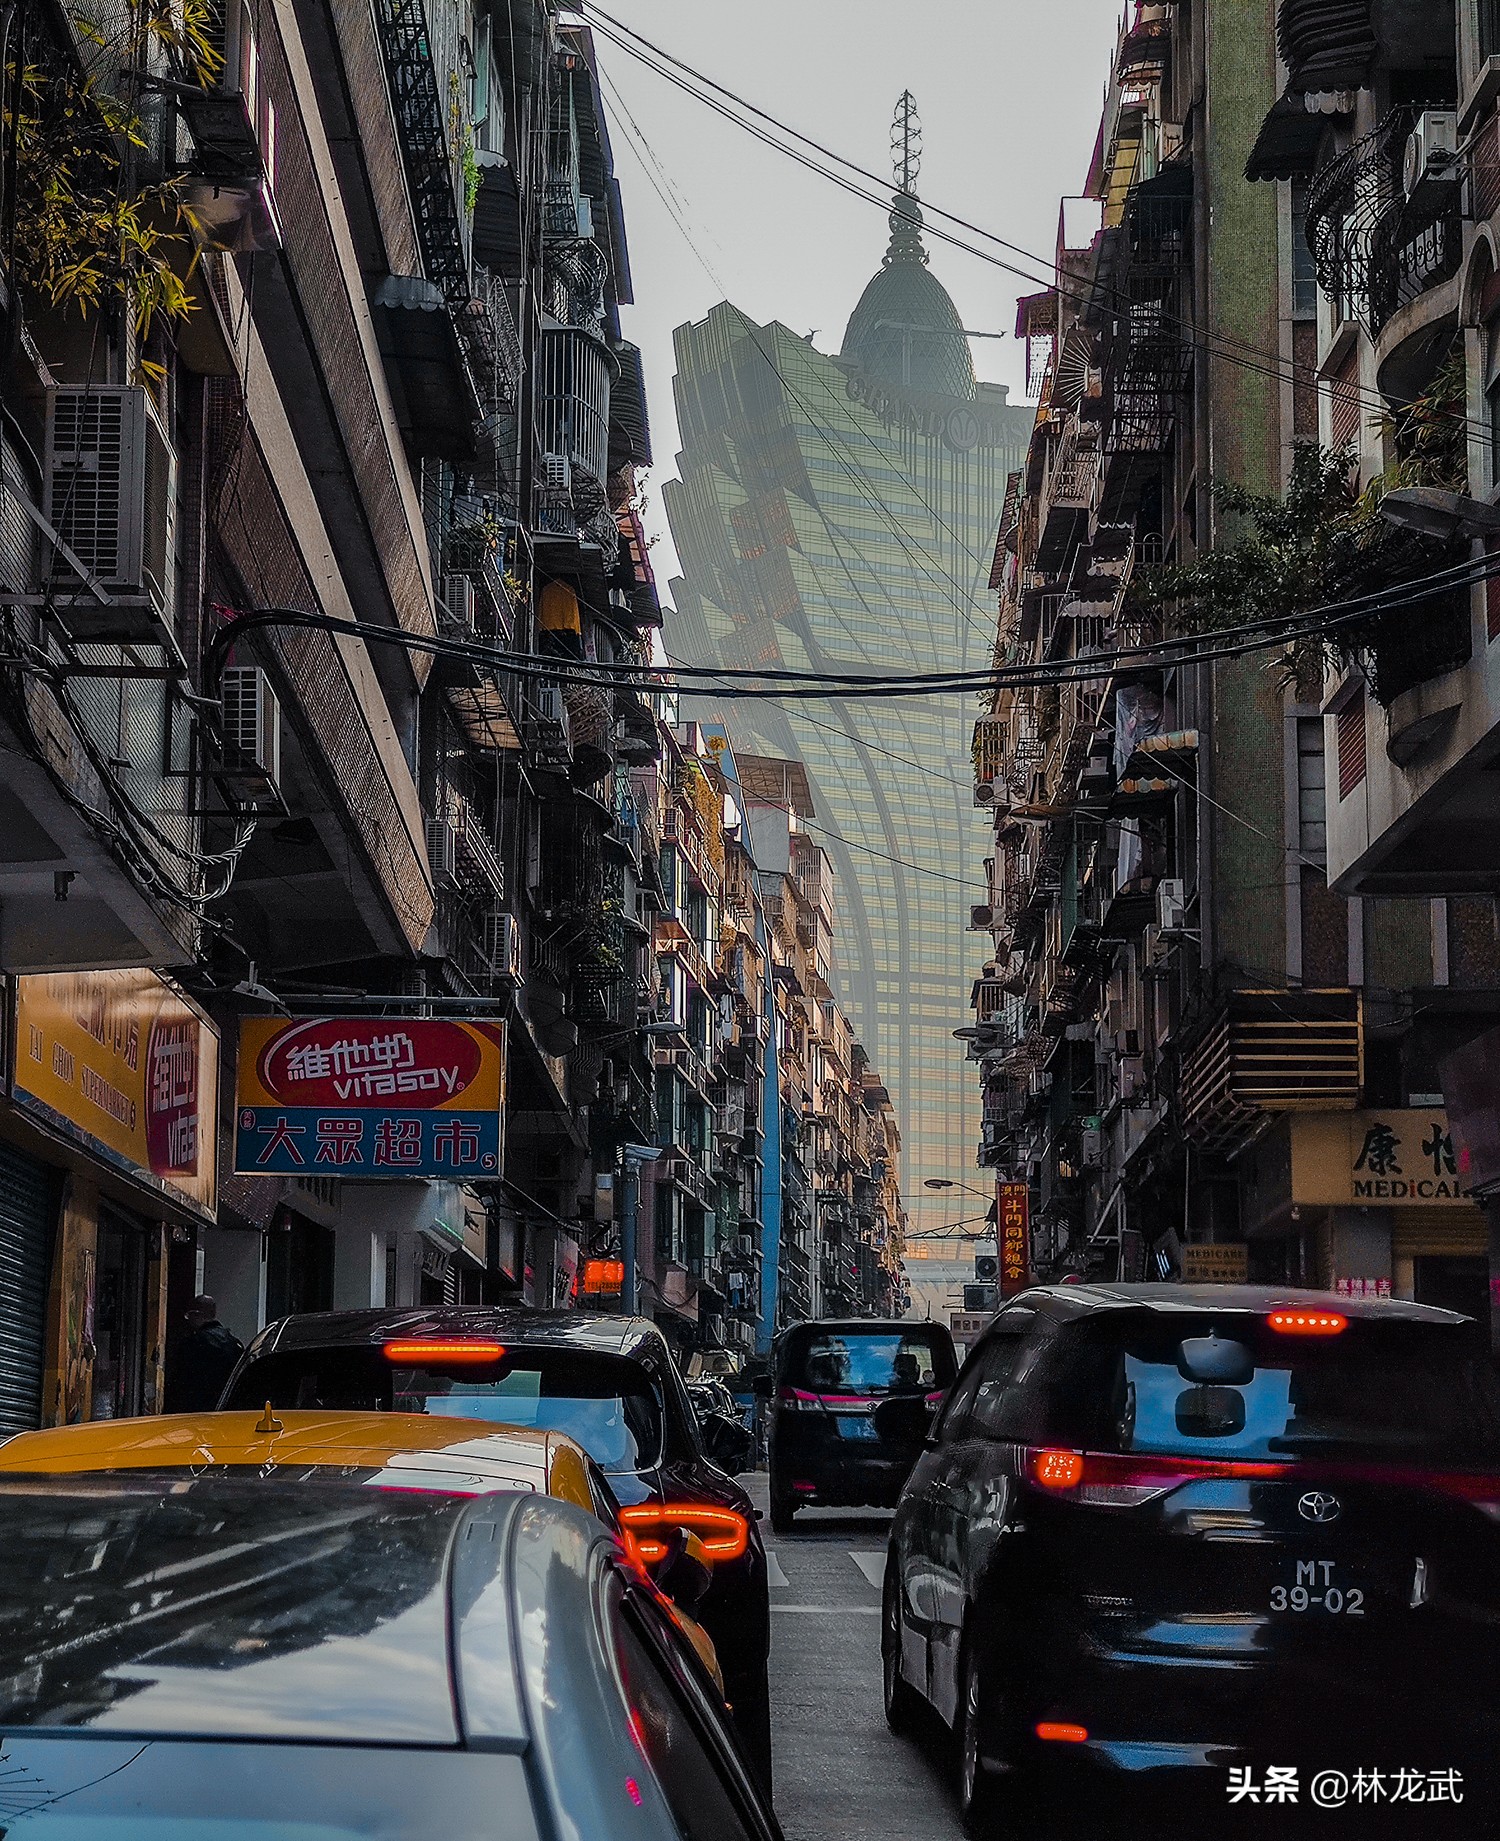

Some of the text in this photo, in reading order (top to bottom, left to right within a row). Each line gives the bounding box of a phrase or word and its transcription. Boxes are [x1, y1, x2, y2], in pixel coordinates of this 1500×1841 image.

[29, 1022, 44, 1064] TAI
[286, 1033, 416, 1081] 維他奶
[333, 1066, 459, 1100] vitasoy
[256, 1116, 481, 1167] 大眾超市
[1005, 1199, 1025, 1279] 斗門同鄉總會
[1296, 1559, 1336, 1587] MT
[1269, 1585, 1366, 1616] 39-02
